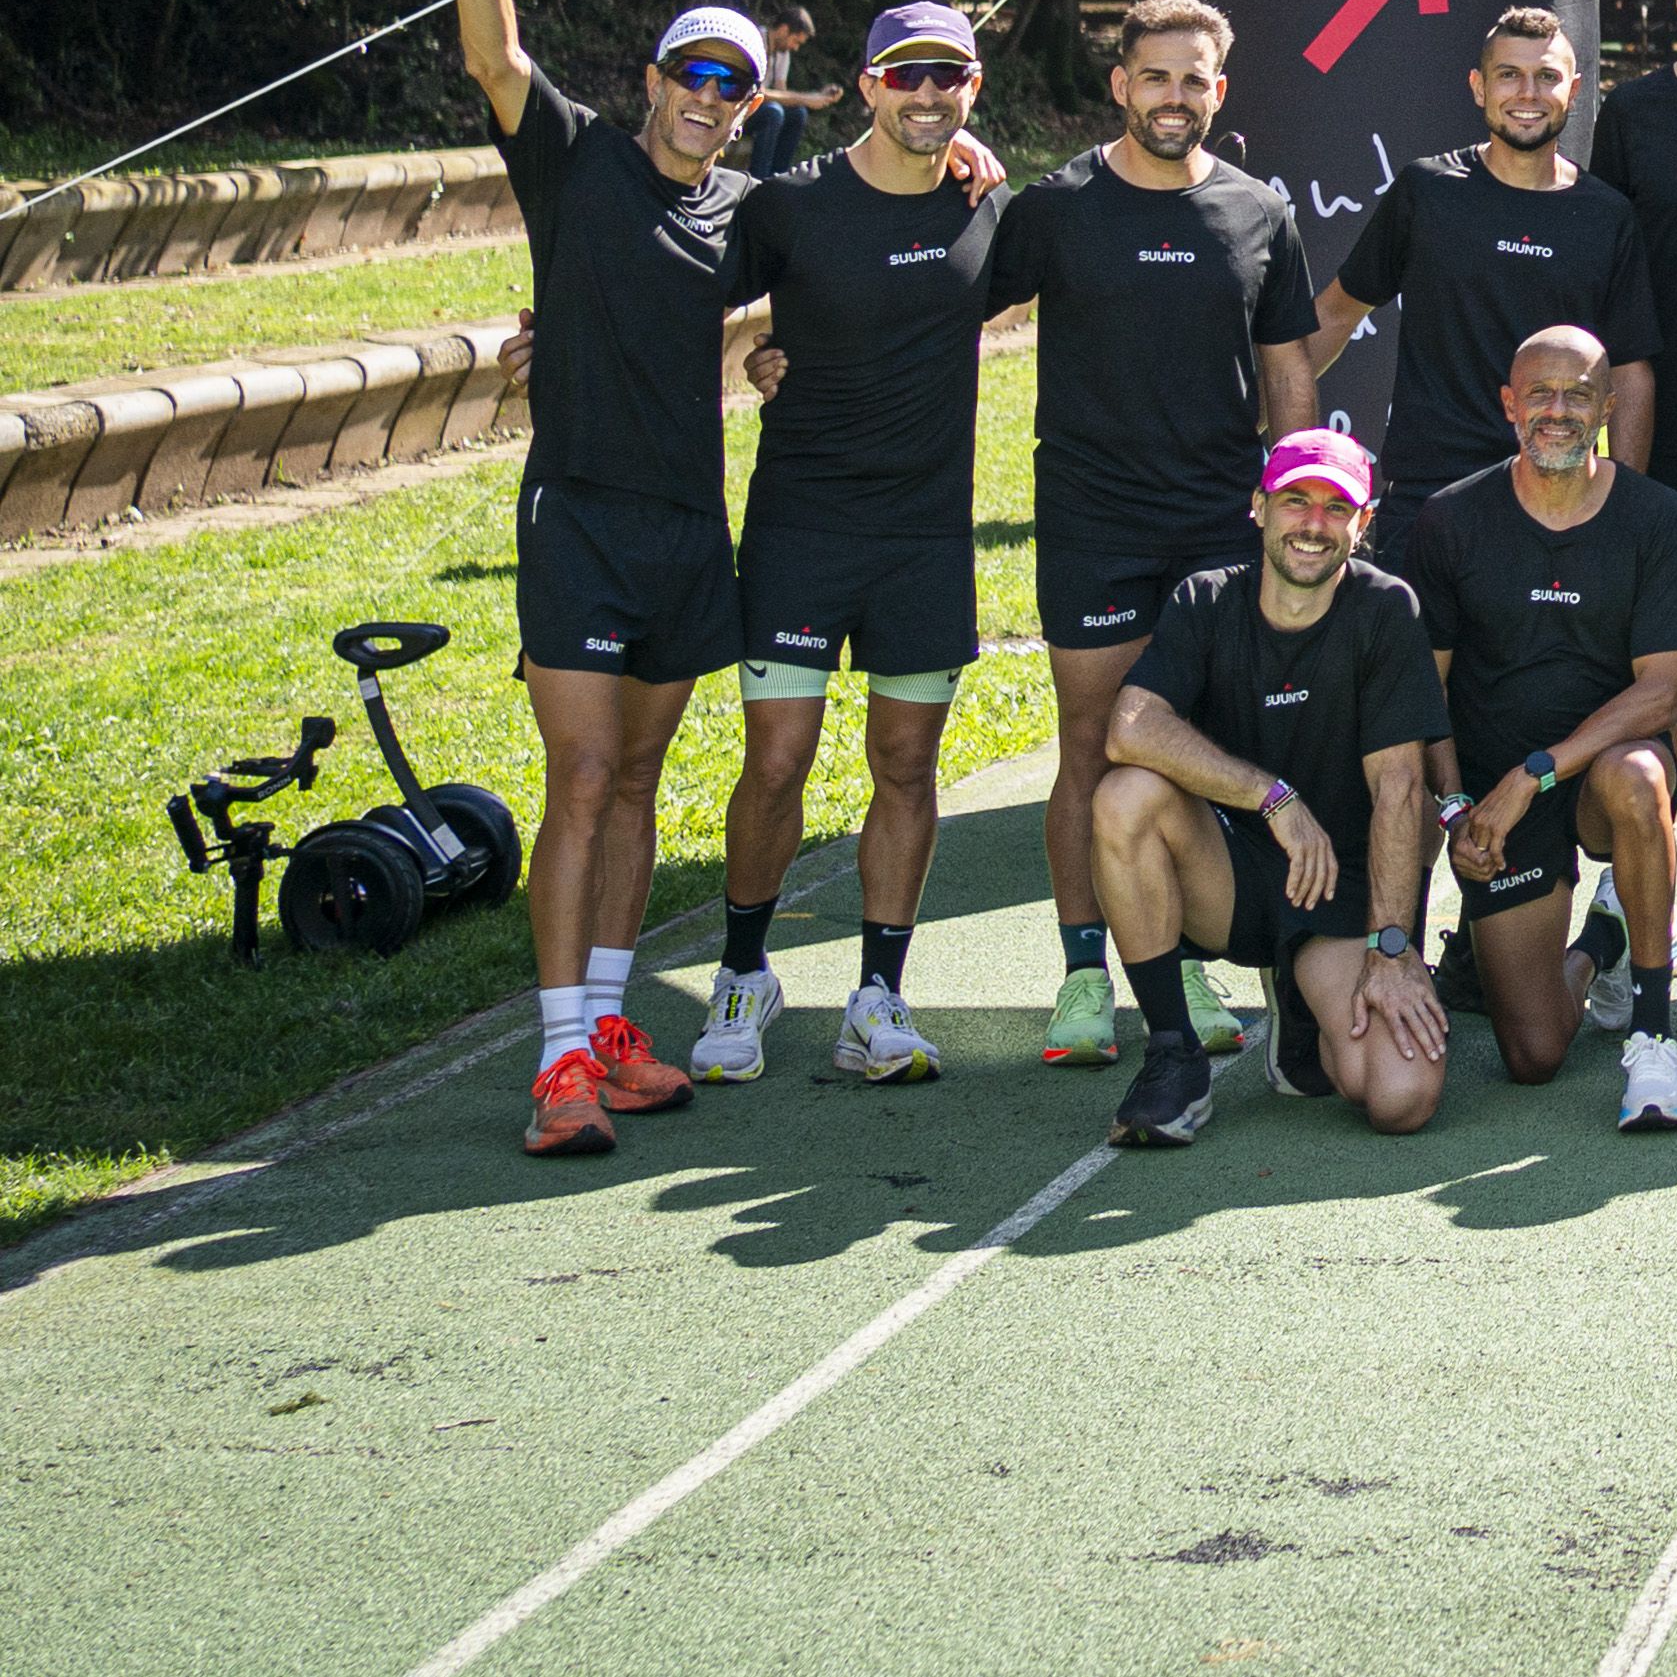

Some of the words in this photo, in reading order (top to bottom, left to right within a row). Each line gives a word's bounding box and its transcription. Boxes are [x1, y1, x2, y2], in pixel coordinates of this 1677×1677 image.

[889, 248, 946, 265] SUUNTO
[1138, 250, 1195, 263] SUUNTO
[1497, 240, 1553, 258] SUUNTO
[1530, 589, 1580, 604] SUUNTO
[1083, 610, 1136, 627] SUUNTO
[775, 632, 827, 649] SUUNTO
[1265, 690, 1310, 706] SUUNTO
[1489, 867, 1544, 893] SUUNTO
